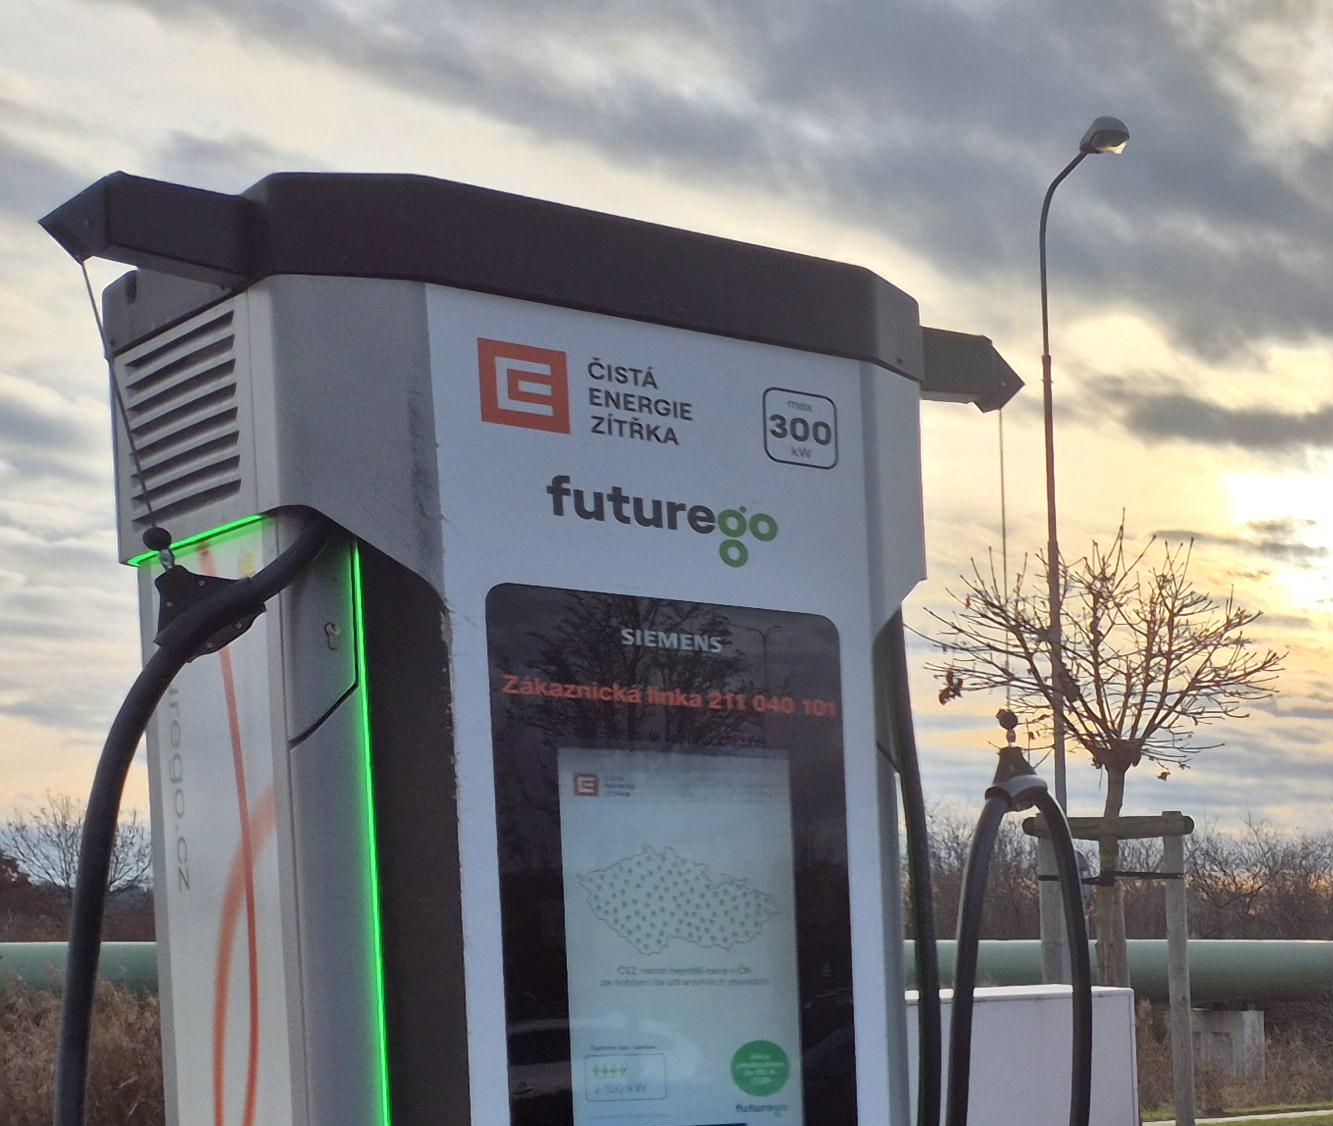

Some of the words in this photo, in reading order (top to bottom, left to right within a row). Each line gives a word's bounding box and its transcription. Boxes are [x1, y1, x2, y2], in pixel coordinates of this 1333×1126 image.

[587, 357, 659, 390] ČISTÁ
[588, 387, 694, 422] ENERGIE
[590, 414, 680, 447] ZÍTŘKA
[769, 414, 832, 446] 300
[546, 474, 778, 568] futurego
[621, 628, 723, 653] SIEMENS
[647, 685, 703, 708] linka
[752, 694, 795, 715] 040
